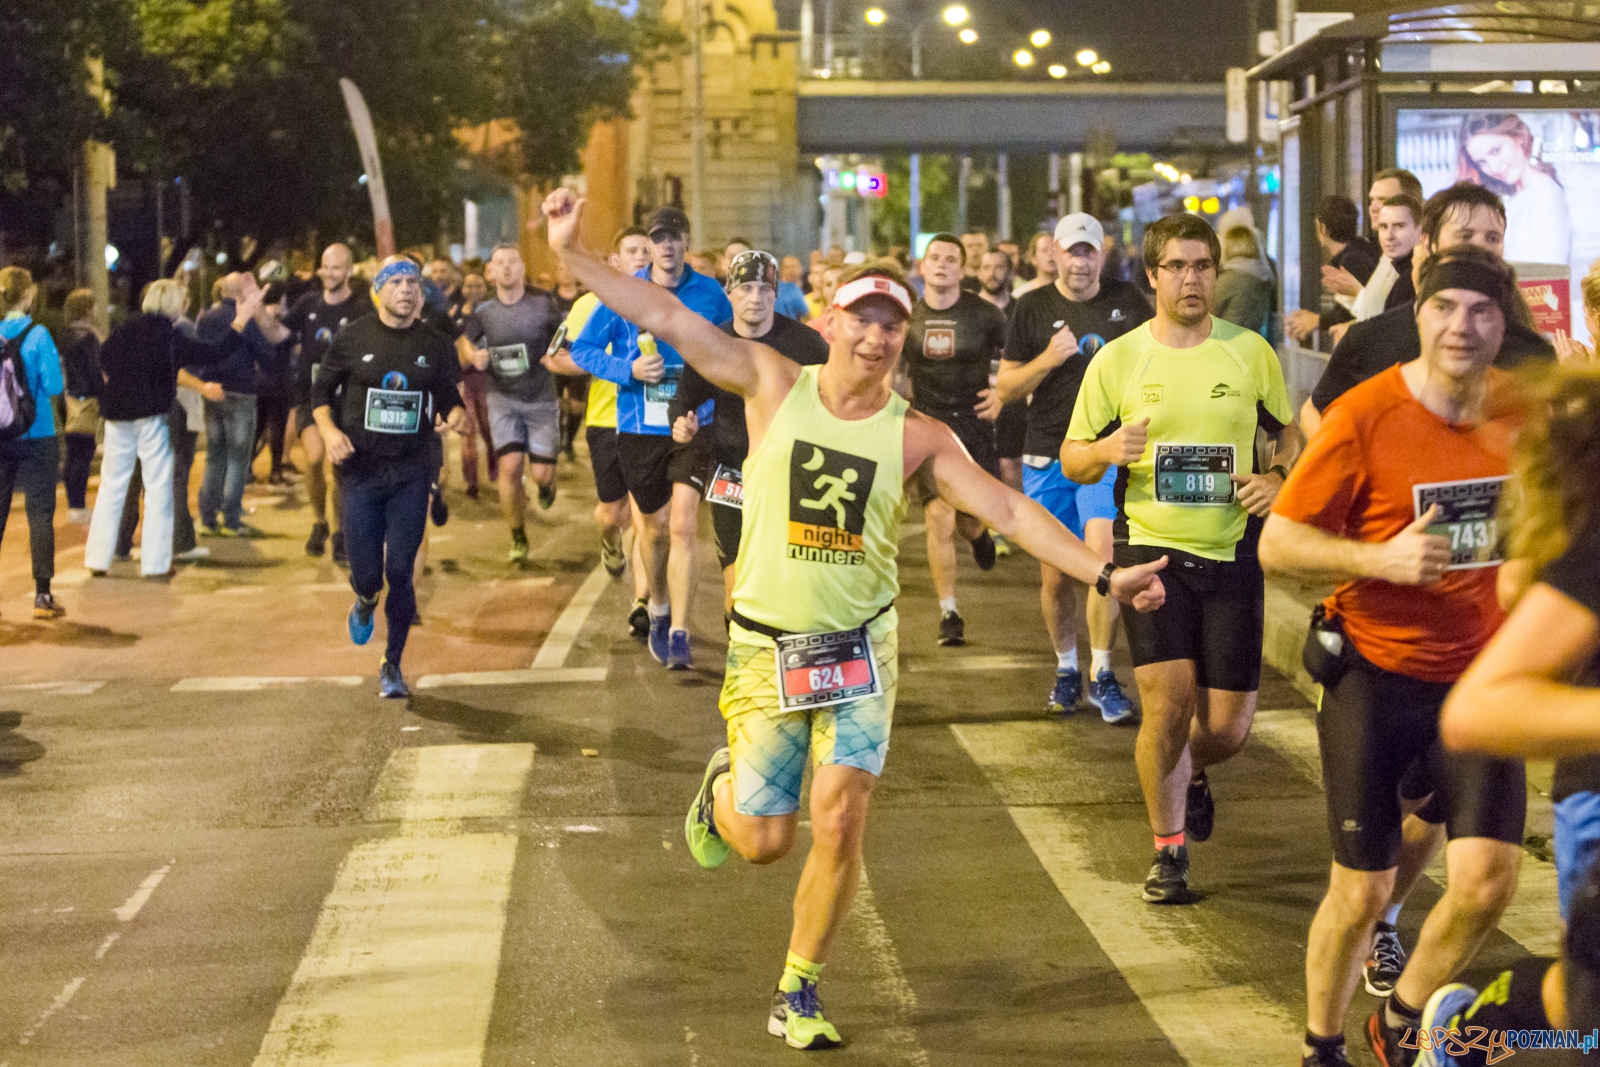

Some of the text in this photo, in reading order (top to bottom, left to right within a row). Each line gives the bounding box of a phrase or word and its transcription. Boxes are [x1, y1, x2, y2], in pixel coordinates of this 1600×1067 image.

[380, 409, 407, 424] 9312
[1185, 473, 1215, 492] 819
[803, 525, 853, 547] night
[787, 543, 866, 565] runners
[808, 665, 845, 691] 624
